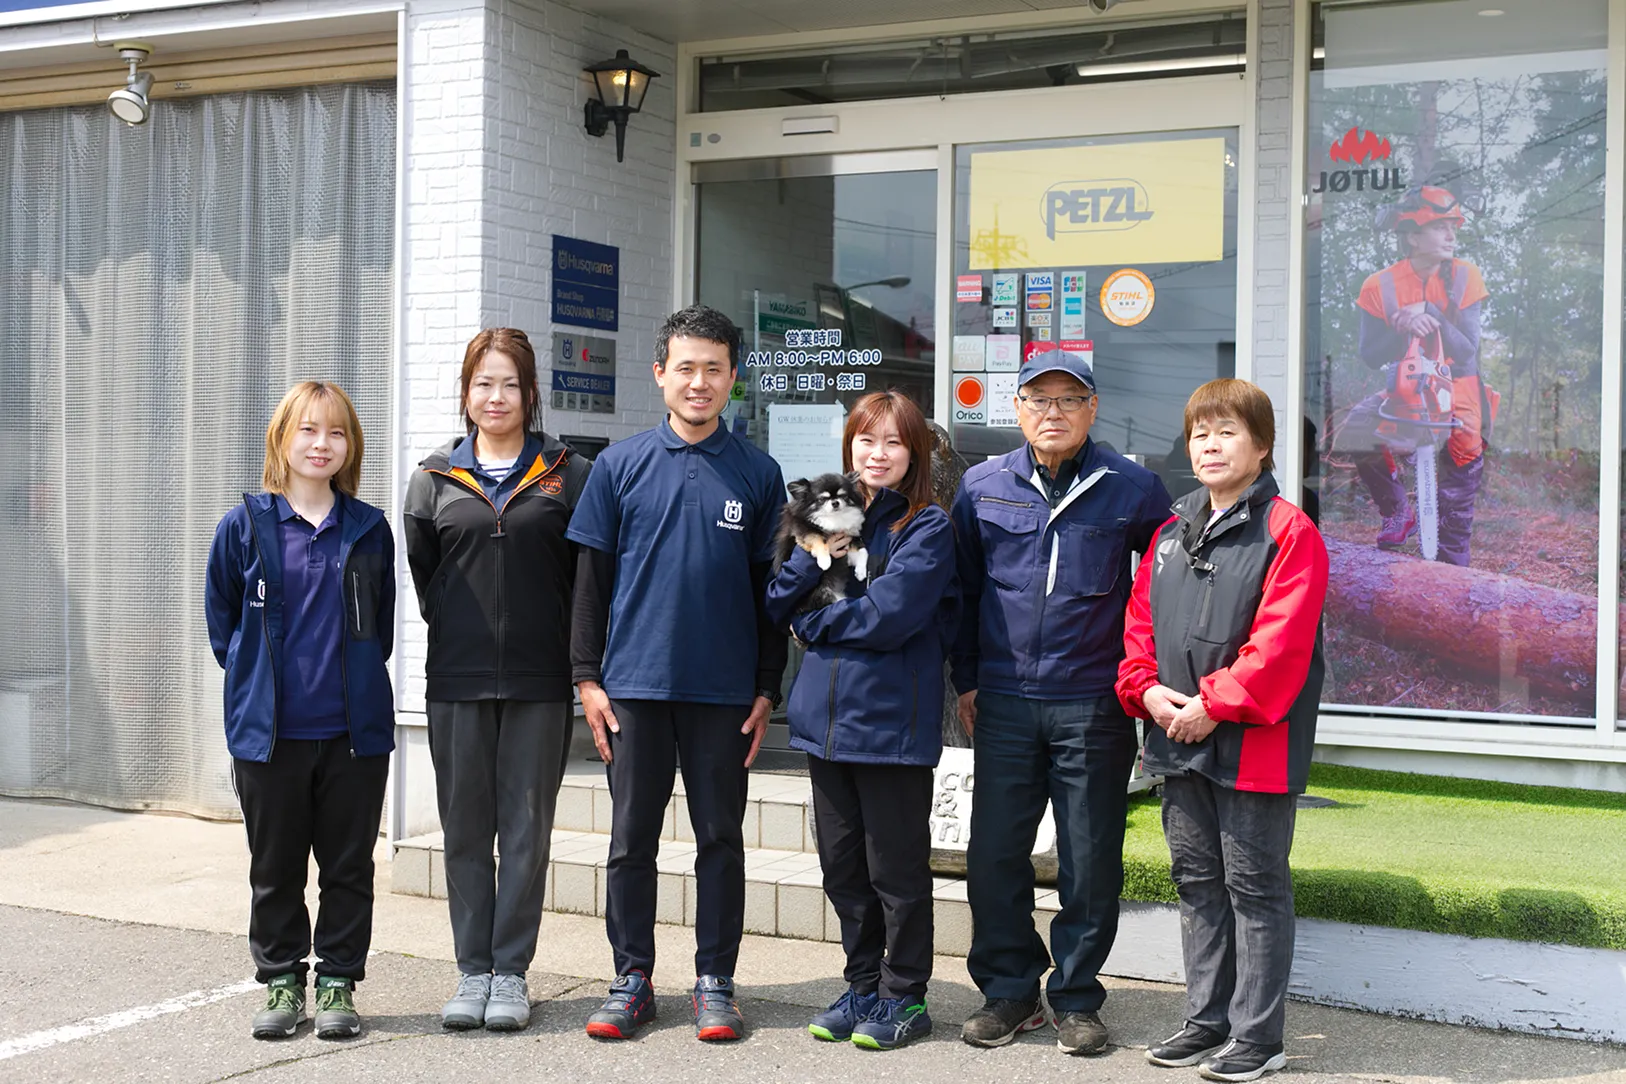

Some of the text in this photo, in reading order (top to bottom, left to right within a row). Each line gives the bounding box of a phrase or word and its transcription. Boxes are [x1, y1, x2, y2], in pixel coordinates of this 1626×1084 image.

[1312, 168, 1407, 193] JØTUL
[1046, 187, 1155, 241] PETZL
[568, 252, 614, 276] Husqvarna
[1029, 276, 1052, 285] VISA
[1110, 291, 1144, 301] STIHL
[556, 302, 596, 319] HUSQVARNA
[786, 329, 842, 347] 営業時間
[746, 351, 771, 367] AM
[848, 348, 882, 366] 6:00
[566, 376, 610, 390] SERVICE DEALER
[761, 374, 788, 391] 休日
[956, 410, 984, 420] Orico
[716, 519, 745, 531] Husqvarna
